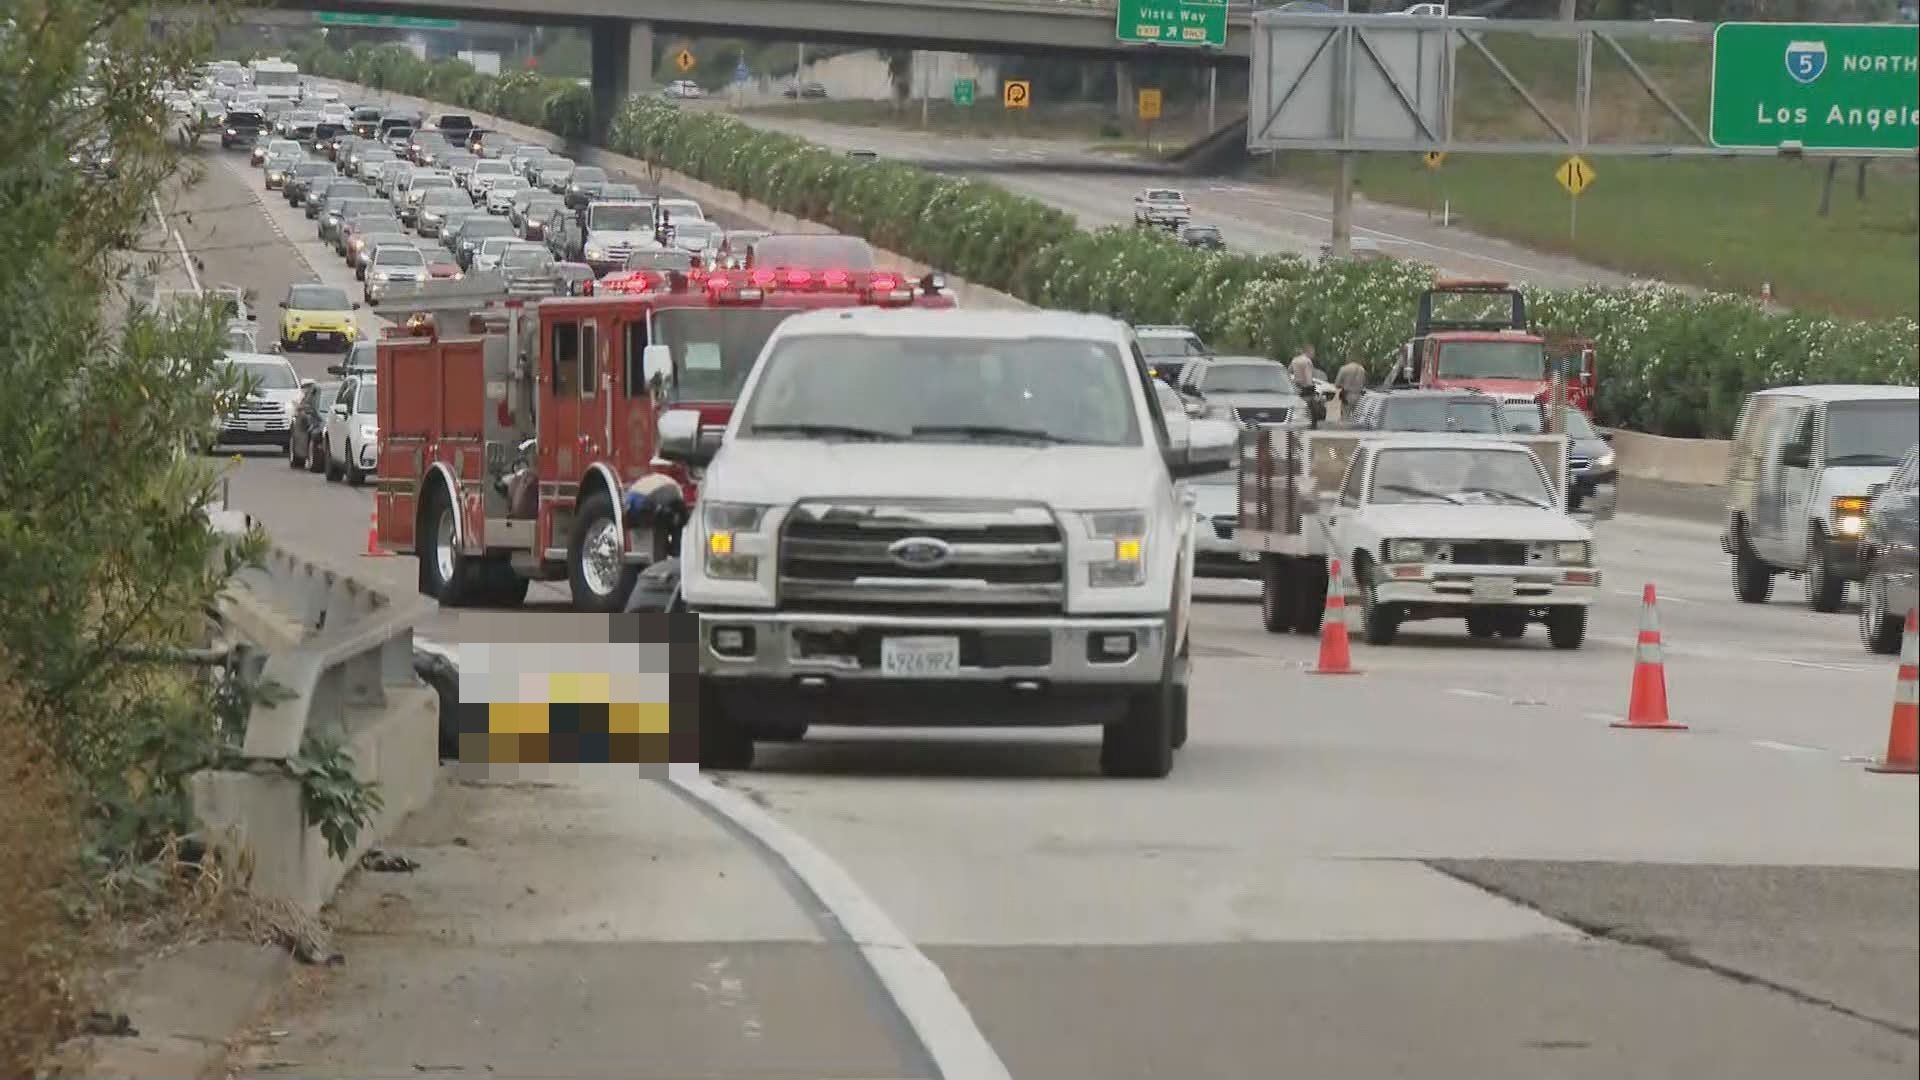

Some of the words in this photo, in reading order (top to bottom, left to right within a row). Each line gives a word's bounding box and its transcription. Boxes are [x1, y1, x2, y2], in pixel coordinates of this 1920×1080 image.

[1140, 8, 1175, 20] Vista
[1180, 9, 1207, 23] Way
[1799, 55, 1812, 74] 5
[1843, 55, 1918, 72] NORTH
[1758, 103, 1808, 125] Los
